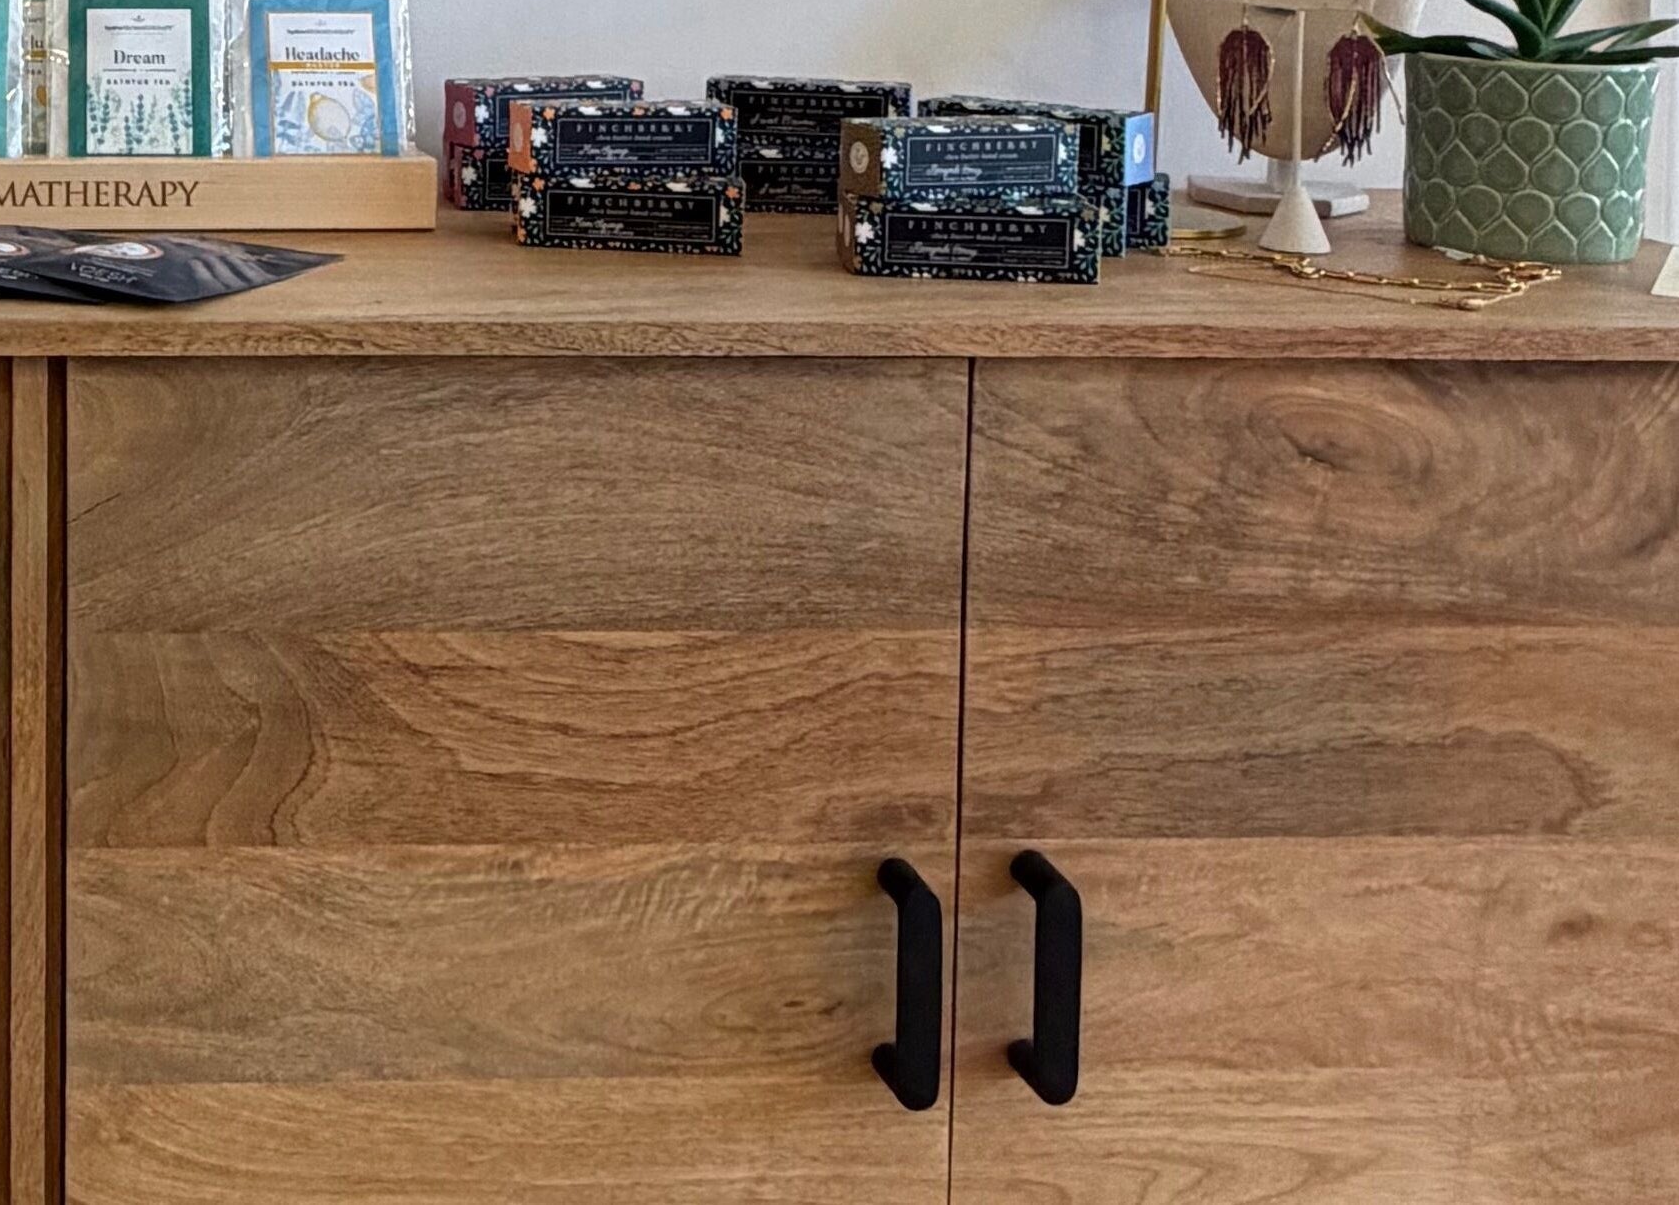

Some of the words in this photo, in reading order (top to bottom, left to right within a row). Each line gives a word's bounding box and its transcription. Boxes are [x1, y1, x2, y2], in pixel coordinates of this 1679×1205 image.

[114, 49, 166, 64] Dream
[285, 46, 360, 61] Headache
[576, 123, 694, 133] FINCHBERRY
[925, 140, 1038, 152] FINCHBERRY
[567, 196, 695, 210] FINCHBERRY
[908, 220, 1047, 234] FINCHBERRY
